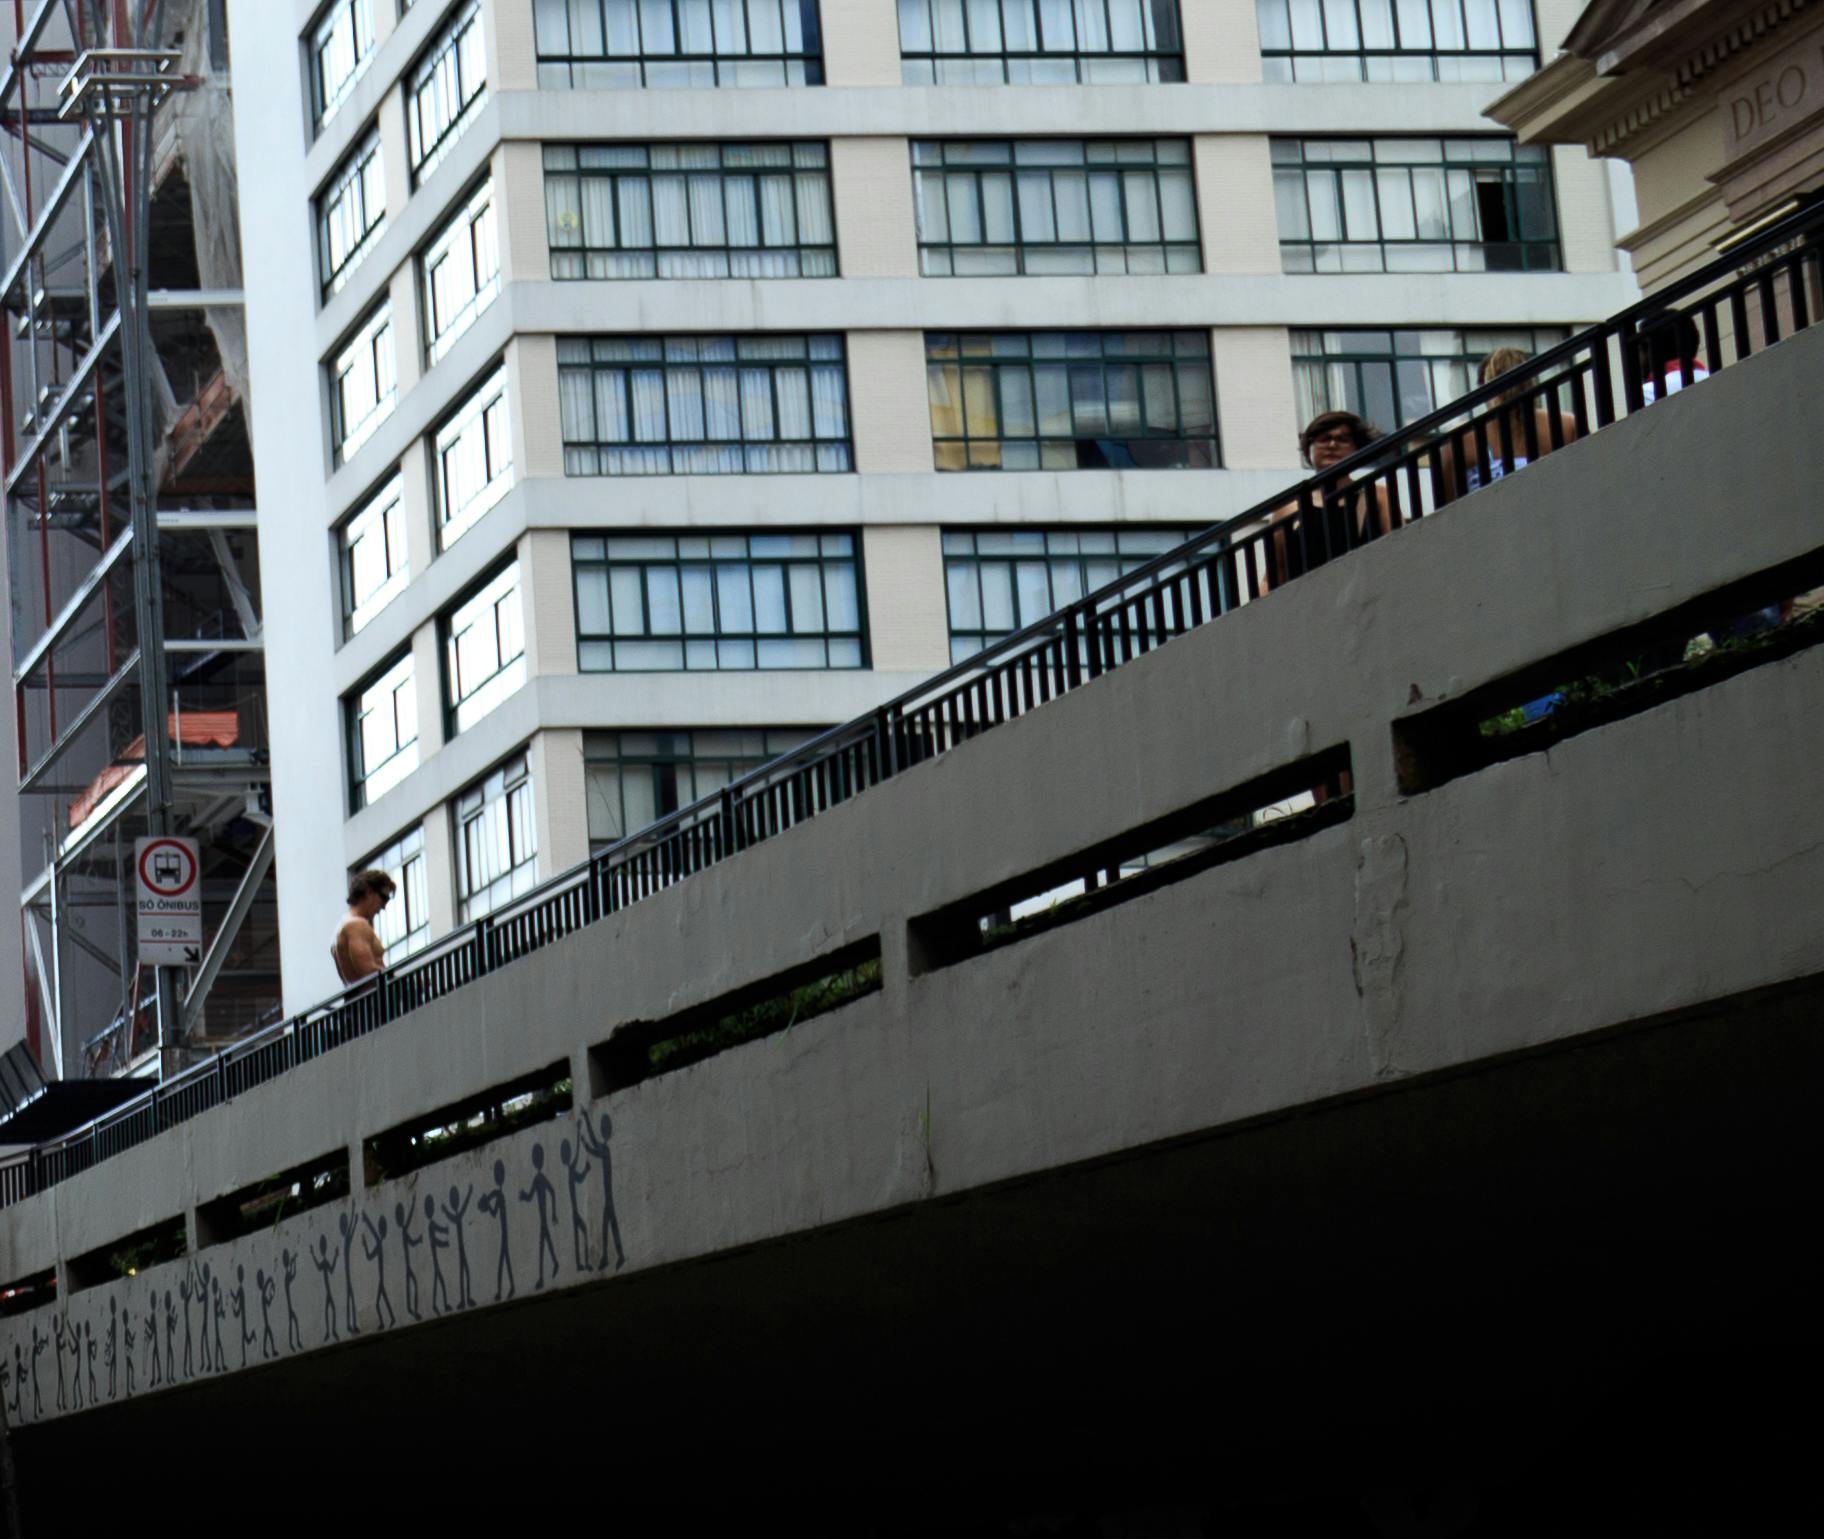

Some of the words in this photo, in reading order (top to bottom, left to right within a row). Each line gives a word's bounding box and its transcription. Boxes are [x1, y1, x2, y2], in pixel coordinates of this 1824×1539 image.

[1729, 64, 1807, 143] DEO
[138, 899, 154, 911] SÓ
[156, 899, 200, 911] ÔNIBUS
